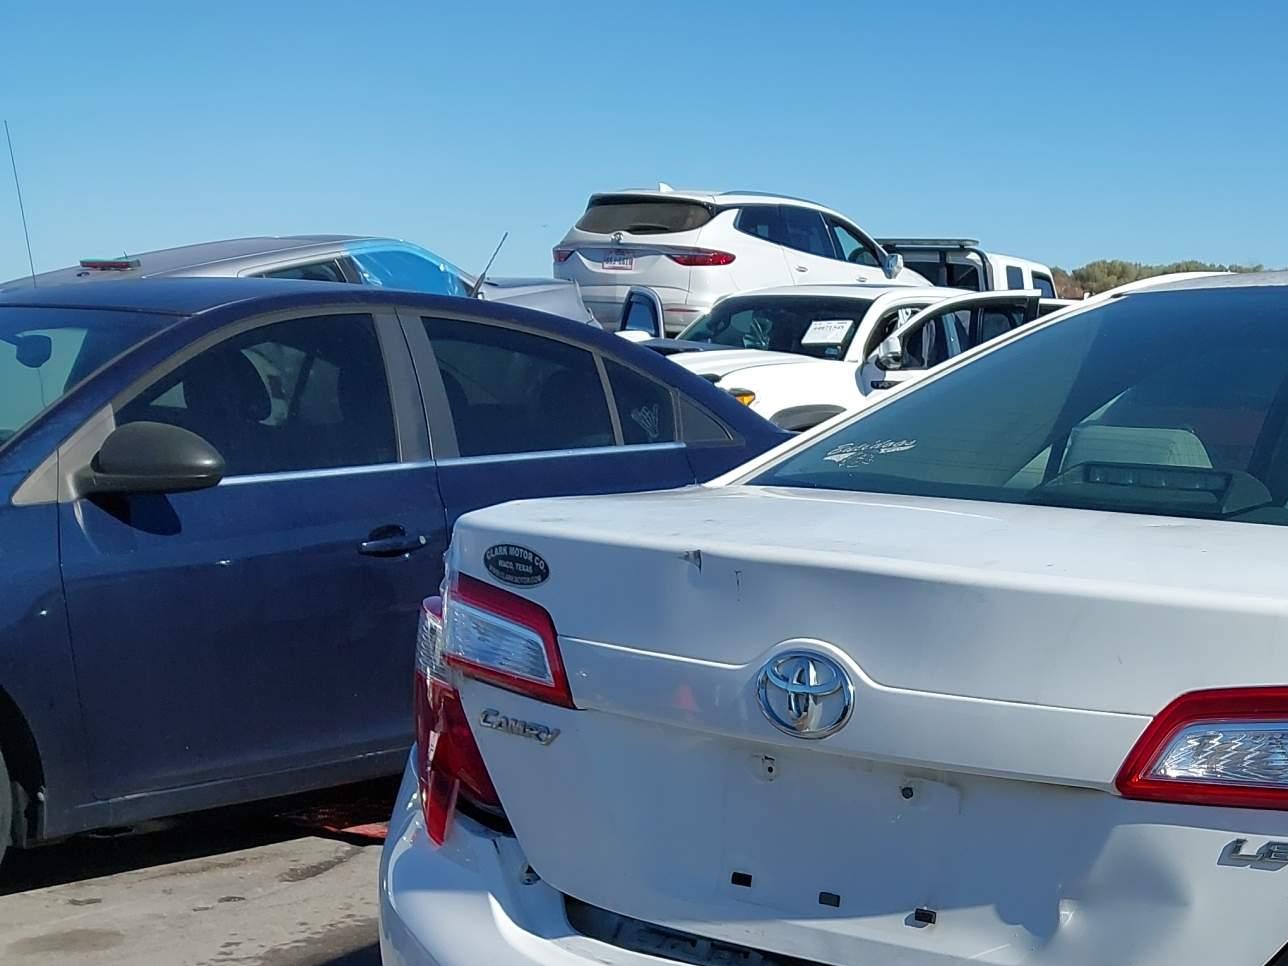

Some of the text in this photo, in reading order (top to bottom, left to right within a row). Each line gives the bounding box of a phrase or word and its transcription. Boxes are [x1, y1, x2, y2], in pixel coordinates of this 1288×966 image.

[486, 545, 547, 573] CLARK MOTOR CO.
